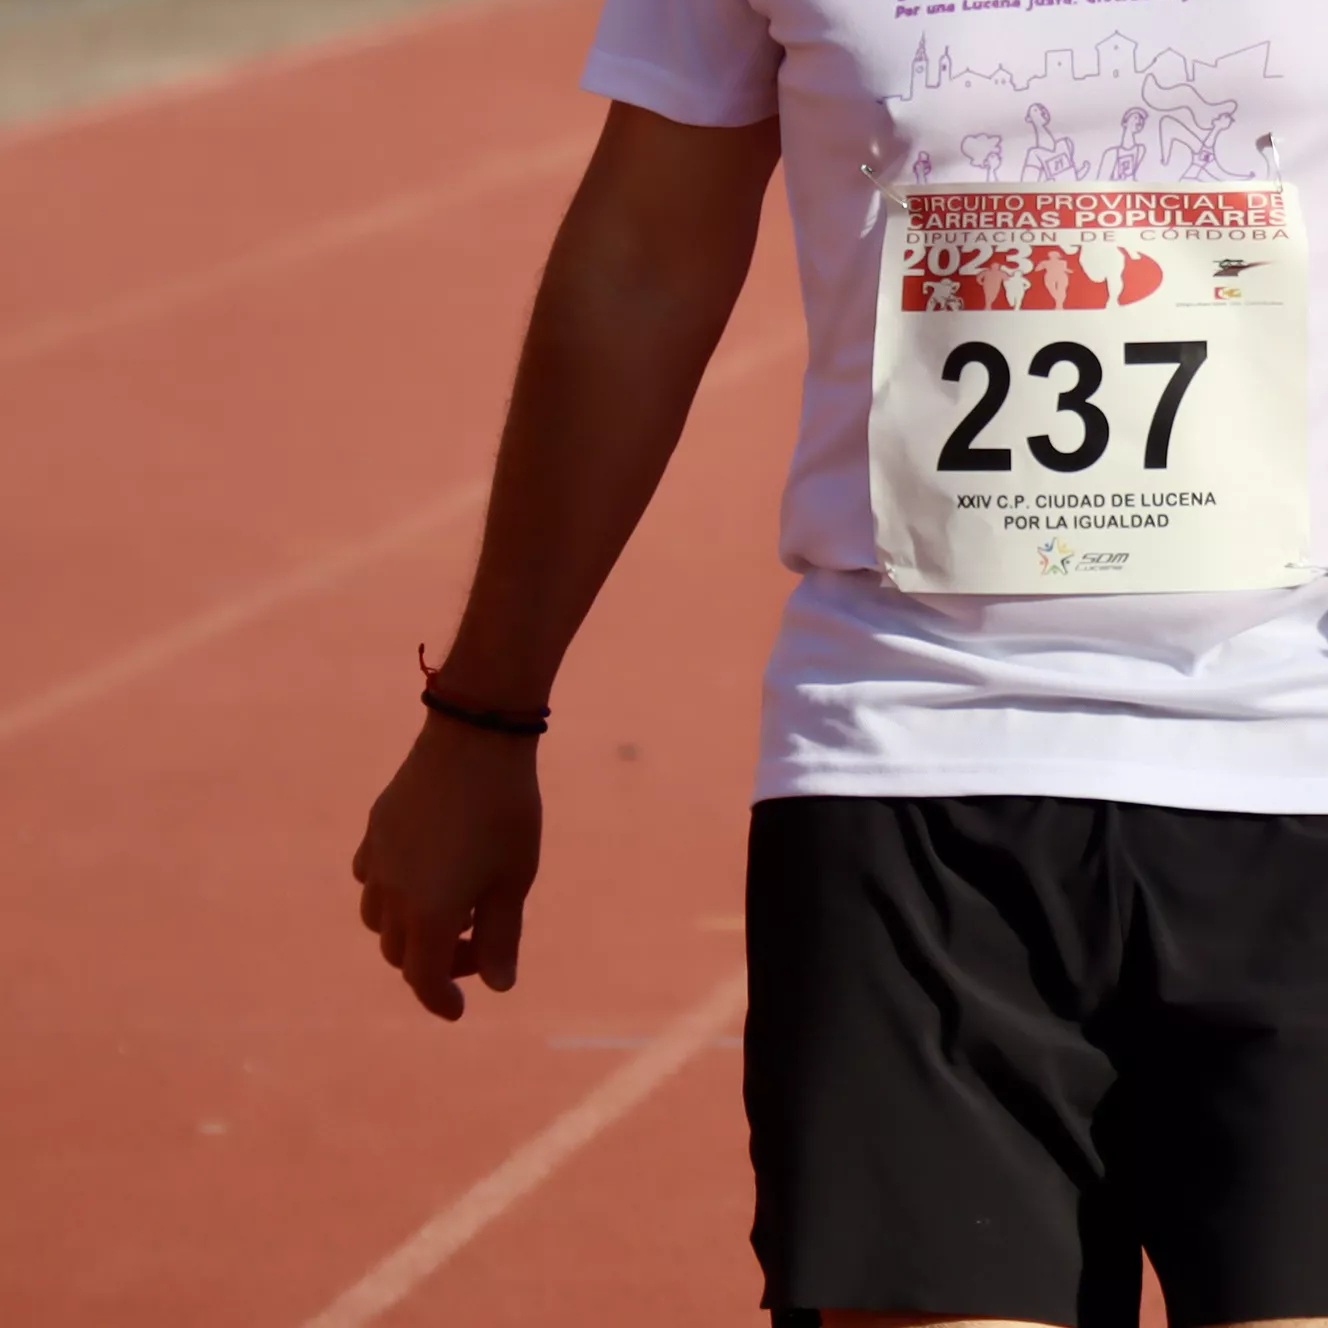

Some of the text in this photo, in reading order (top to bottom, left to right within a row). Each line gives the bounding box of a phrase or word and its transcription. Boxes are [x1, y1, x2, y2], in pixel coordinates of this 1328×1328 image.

[894, 3, 920, 19] Por
[926, 2, 956, 15] una
[907, 193, 1284, 213] CIRCUITO PROVINCIAL DE
[907, 208, 1287, 229] CARRERAS POPULARES
[906, 227, 1289, 245] DIPUTACIÓN DE CÓRDOBA
[902, 244, 1034, 277] 2023
[936, 341, 1208, 473] 237
[956, 492, 1217, 509] XXIV C.P. CIUDAD DE LUCENA
[1004, 514, 1170, 530] POR LA IGUALDAD
